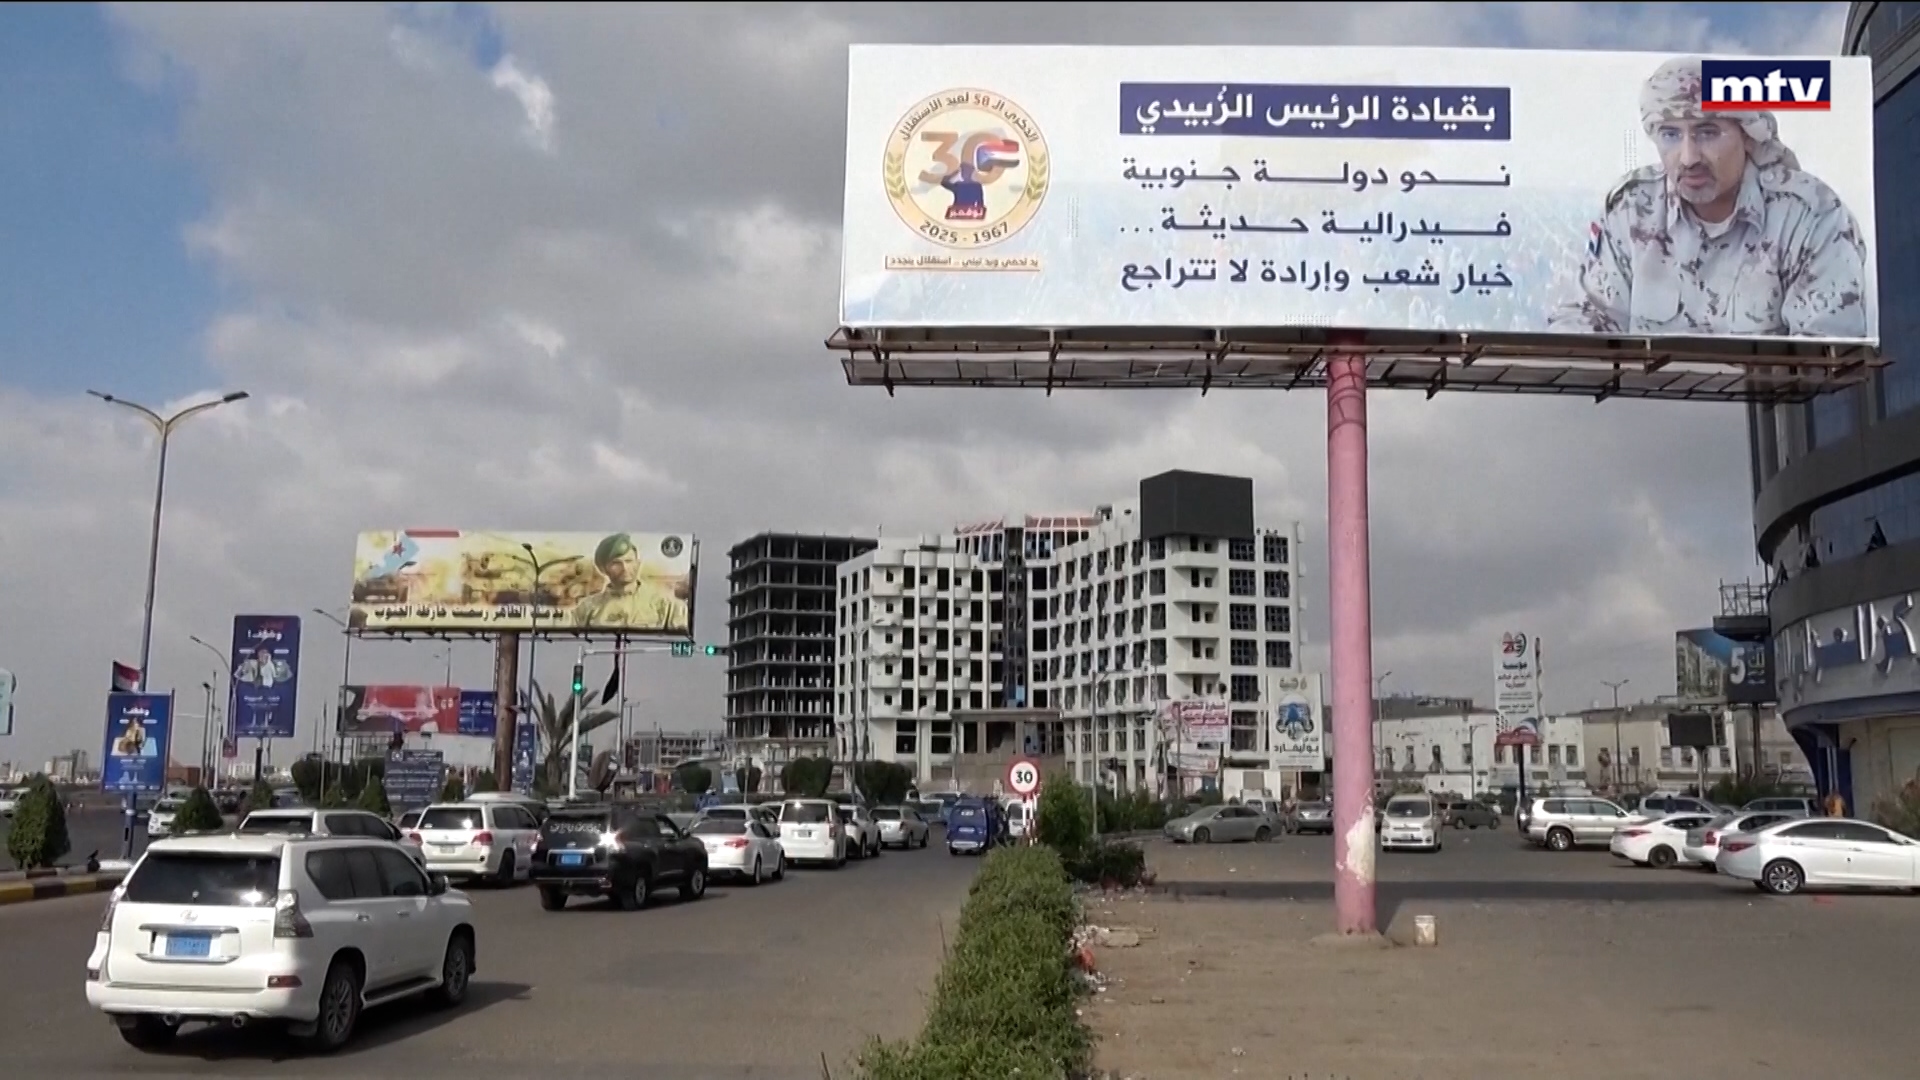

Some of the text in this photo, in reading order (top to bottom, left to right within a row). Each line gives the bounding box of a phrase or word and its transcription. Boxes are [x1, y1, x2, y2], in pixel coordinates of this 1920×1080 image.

[973, 93, 990, 107] 58
[1266, 93, 1379, 129] الرئيس
[1392, 94, 1495, 131] بقيادة
[1123, 157, 1511, 193] نحو دولة جنوبية
[919, 220, 958, 244] 2025
[973, 221, 1008, 243] 1967
[1321, 210, 1512, 244] فيدرالية
[1121, 257, 1513, 294] خيار شعب وإرادة لا تتراجع
[1730, 647, 1746, 685] 5
[1016, 771, 1033, 784] 30
